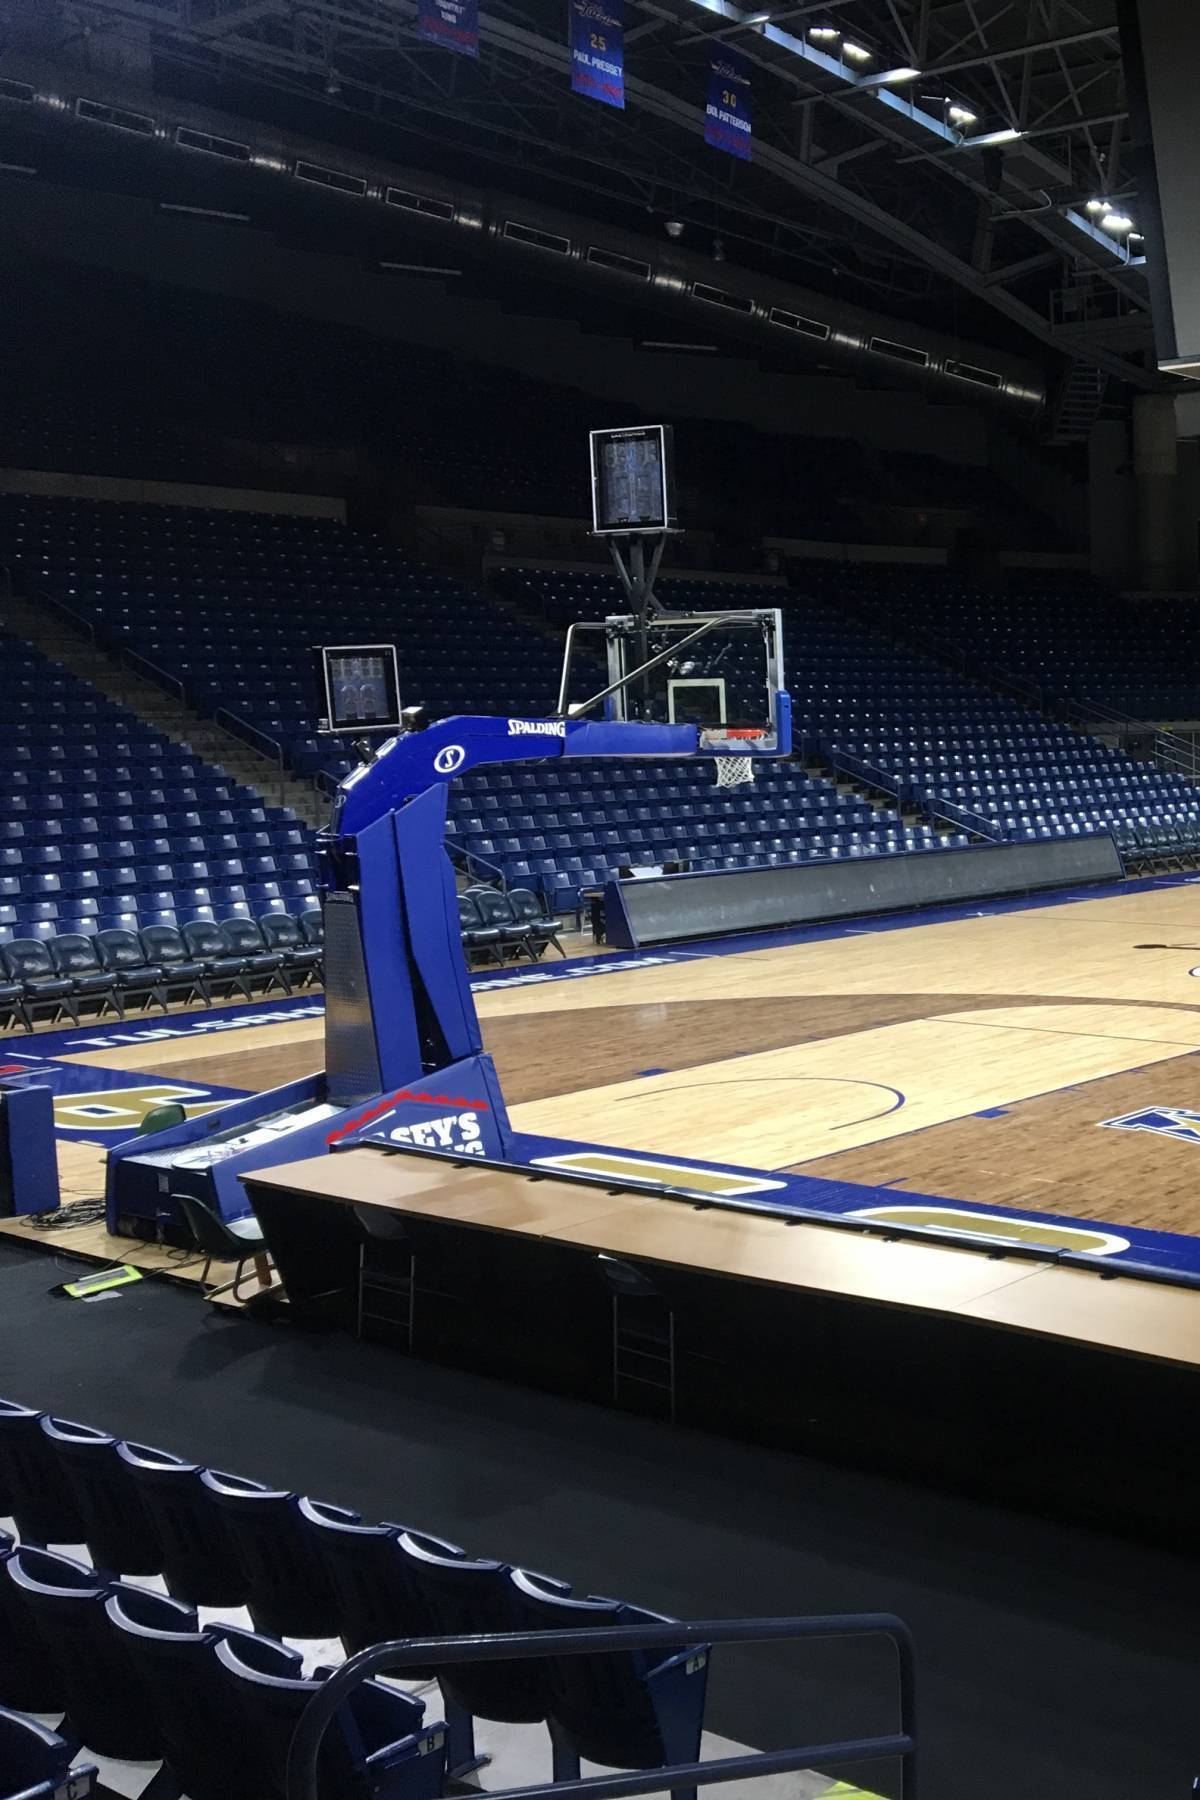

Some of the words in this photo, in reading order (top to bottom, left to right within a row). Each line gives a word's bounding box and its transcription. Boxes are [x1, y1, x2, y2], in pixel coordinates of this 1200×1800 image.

[590, 33, 607, 52] 25
[573, 49, 591, 66] PAUL
[591, 56, 623, 77] PRESSEY
[722, 90, 737, 108] 30
[718, 107, 752, 134] PATTERSON
[507, 719, 566, 738] SPALDING
